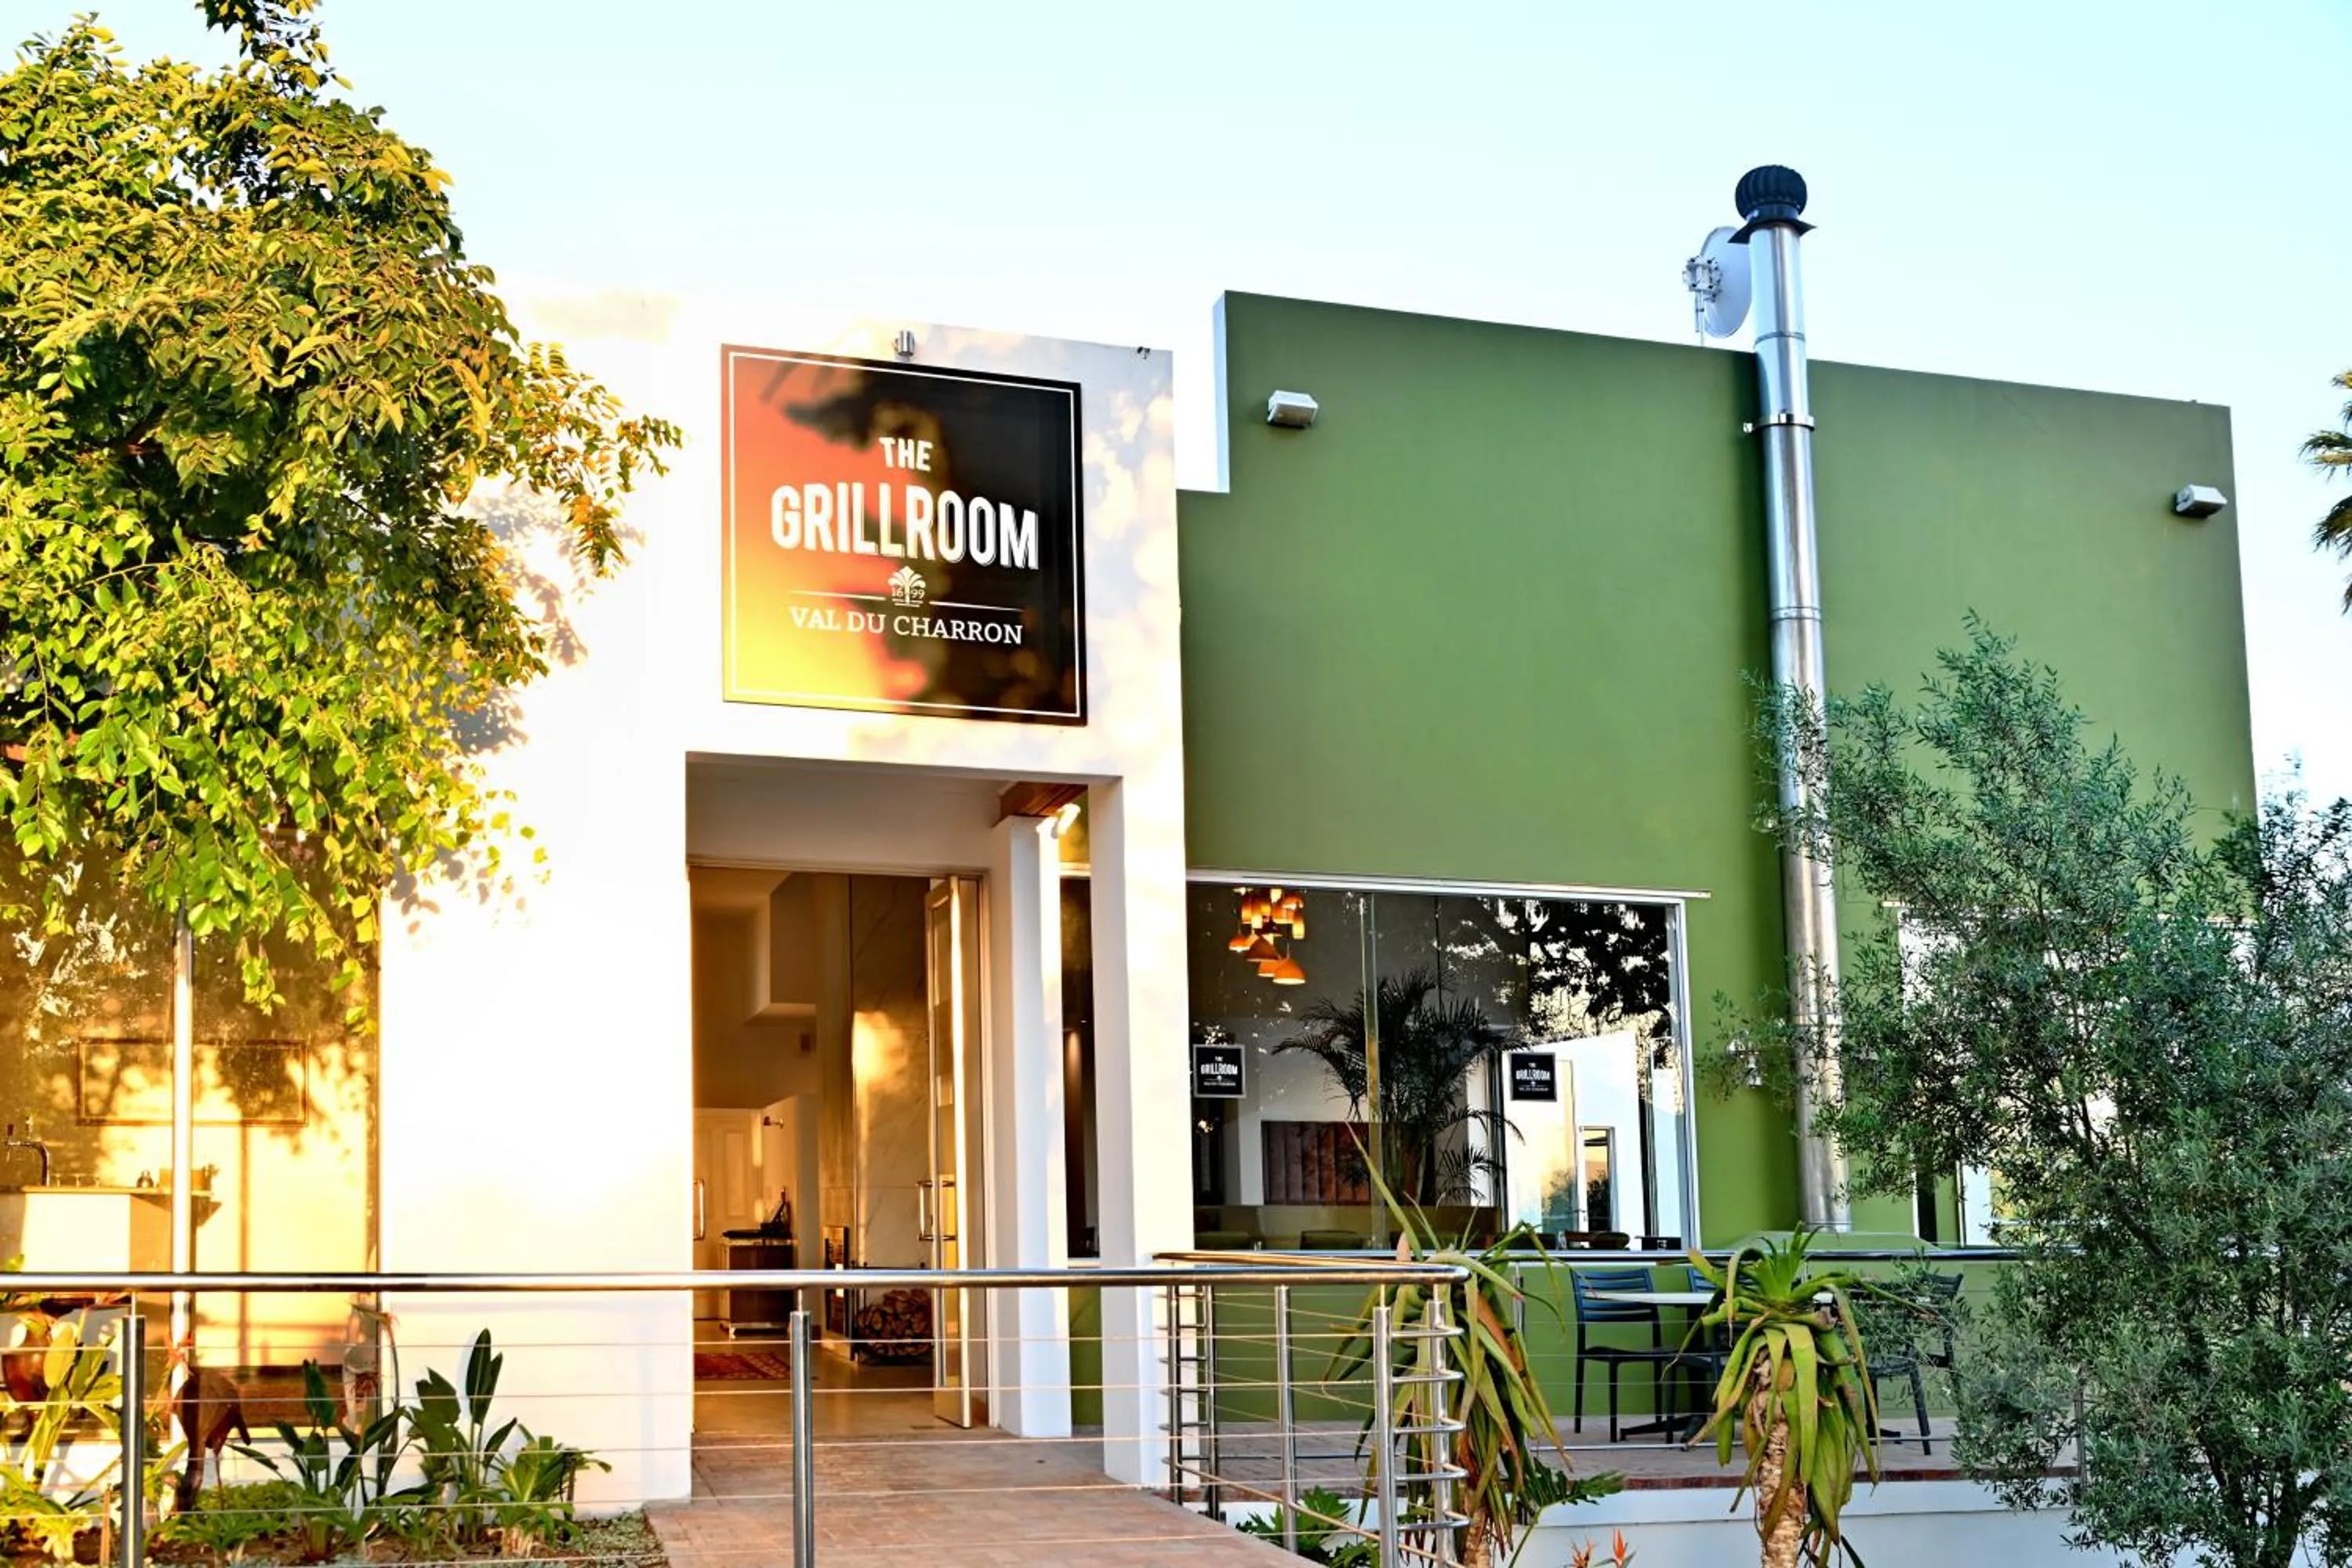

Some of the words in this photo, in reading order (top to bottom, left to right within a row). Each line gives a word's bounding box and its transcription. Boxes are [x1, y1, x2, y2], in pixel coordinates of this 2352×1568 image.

[879, 437, 933, 471] THE
[771, 482, 1039, 570] GRILLROOM
[789, 606, 841, 631] VAL
[848, 612, 886, 634] DU
[893, 615, 1023, 645] CHARRON
